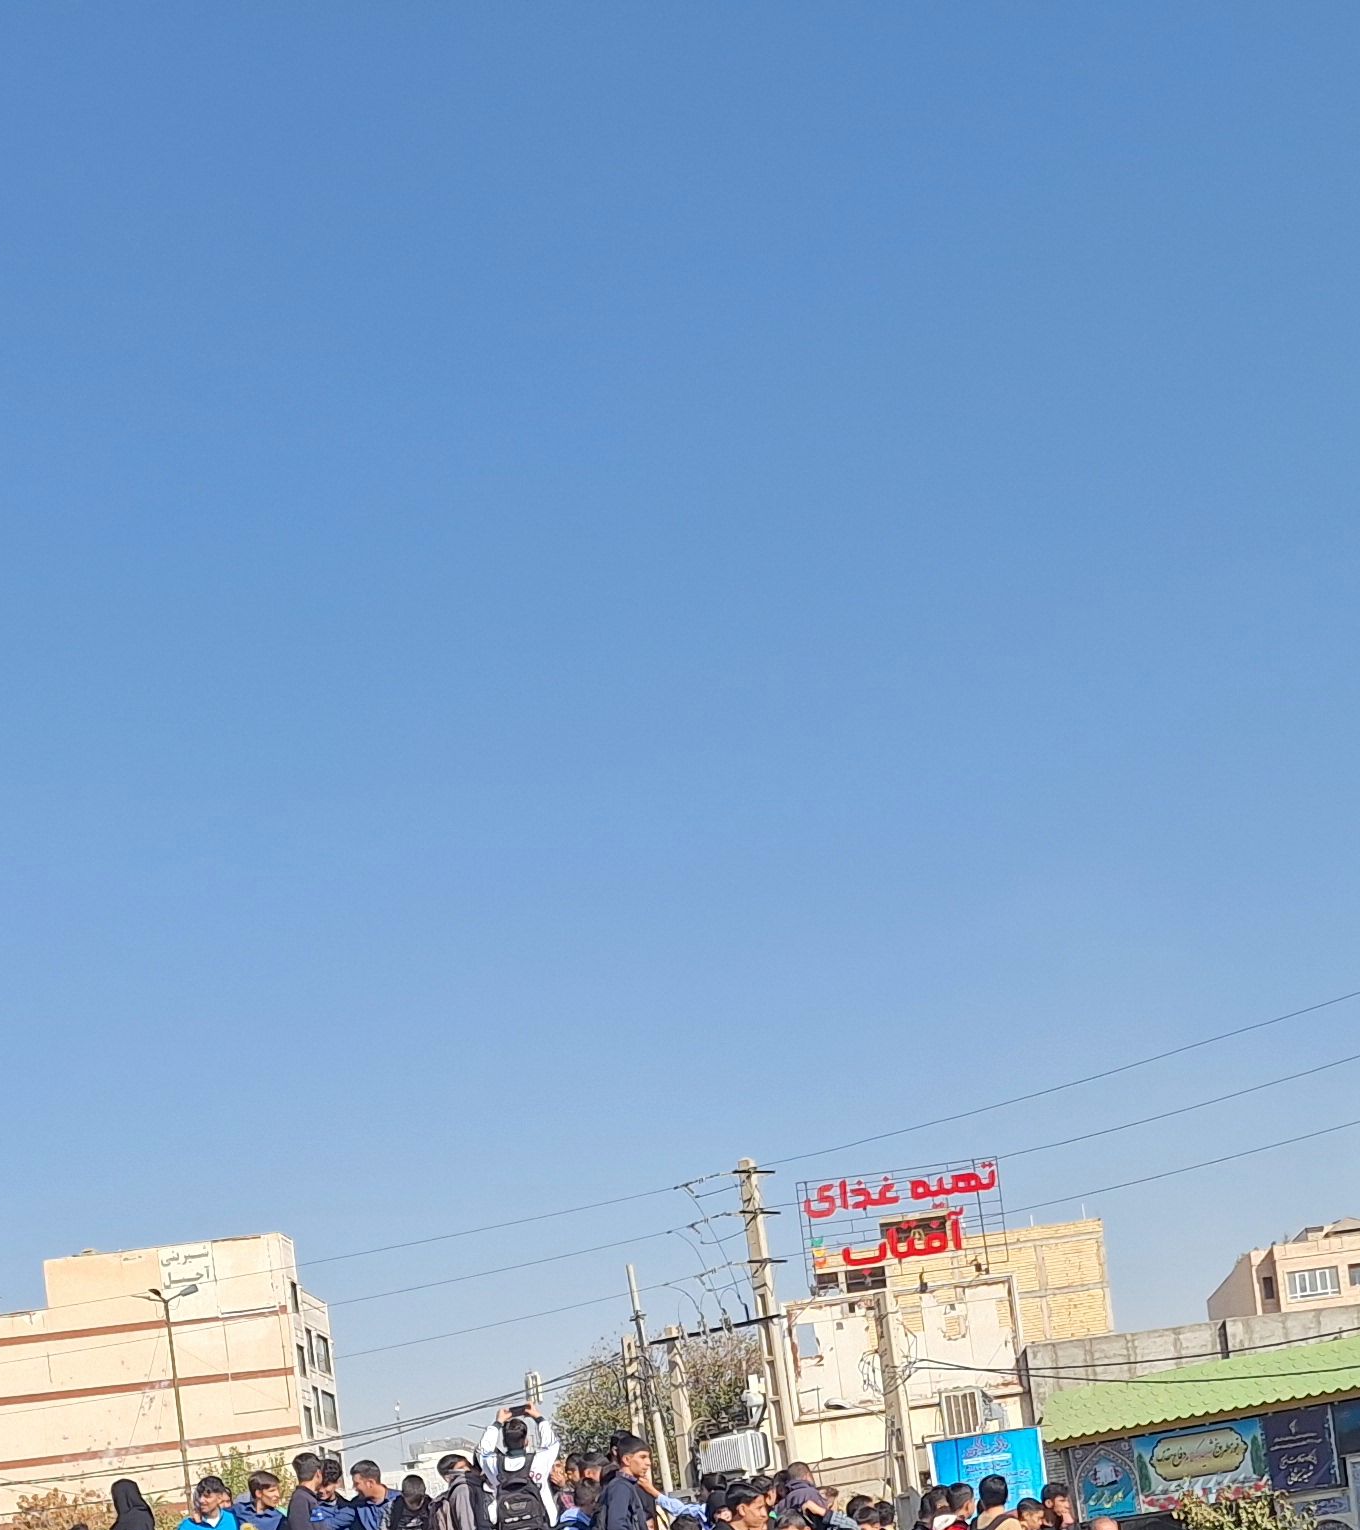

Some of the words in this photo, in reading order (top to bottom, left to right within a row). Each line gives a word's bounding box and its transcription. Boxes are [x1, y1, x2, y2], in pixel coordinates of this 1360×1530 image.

[803, 1176, 901, 1219] غذای
[909, 1161, 997, 1210] تهیه
[842, 1206, 965, 1276] آفتاب
